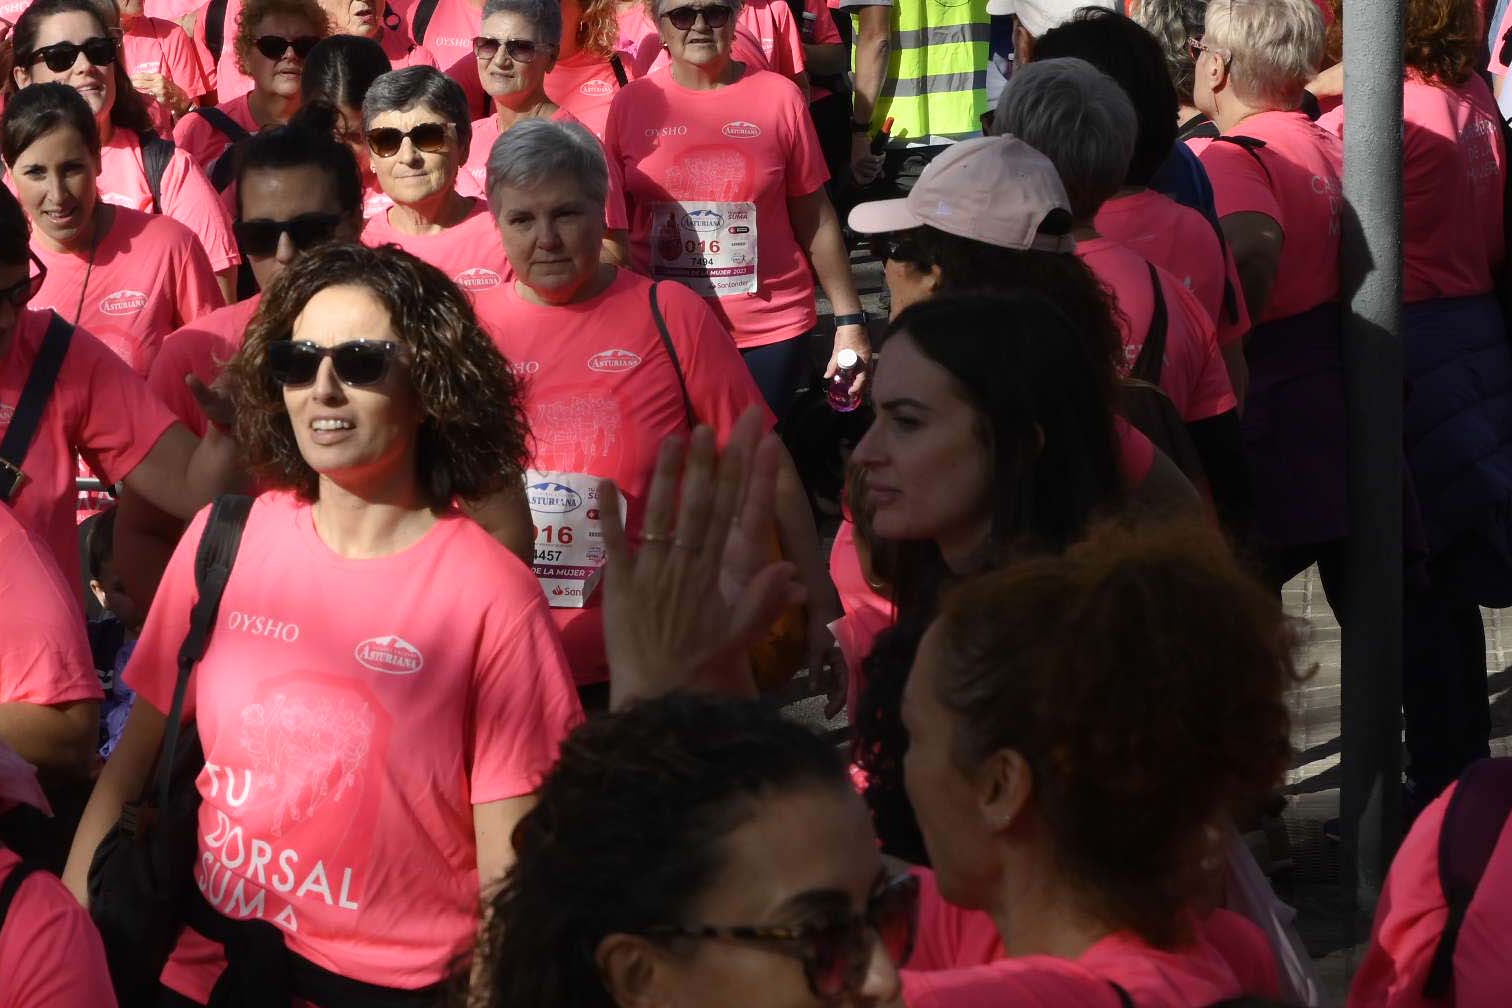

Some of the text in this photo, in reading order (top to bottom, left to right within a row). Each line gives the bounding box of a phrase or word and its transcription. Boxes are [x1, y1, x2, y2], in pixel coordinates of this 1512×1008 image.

[685, 240, 720, 254] 016
[103, 298, 145, 311] ASTURIANA
[592, 357, 639, 369] ASTURIANA
[543, 568, 554, 576] LA
[556, 569, 585, 577] MUJER
[228, 610, 300, 644] OYSHO
[362, 644, 418, 671] ASTURIANA
[205, 760, 250, 807] TU
[204, 809, 359, 910] DORSAL
